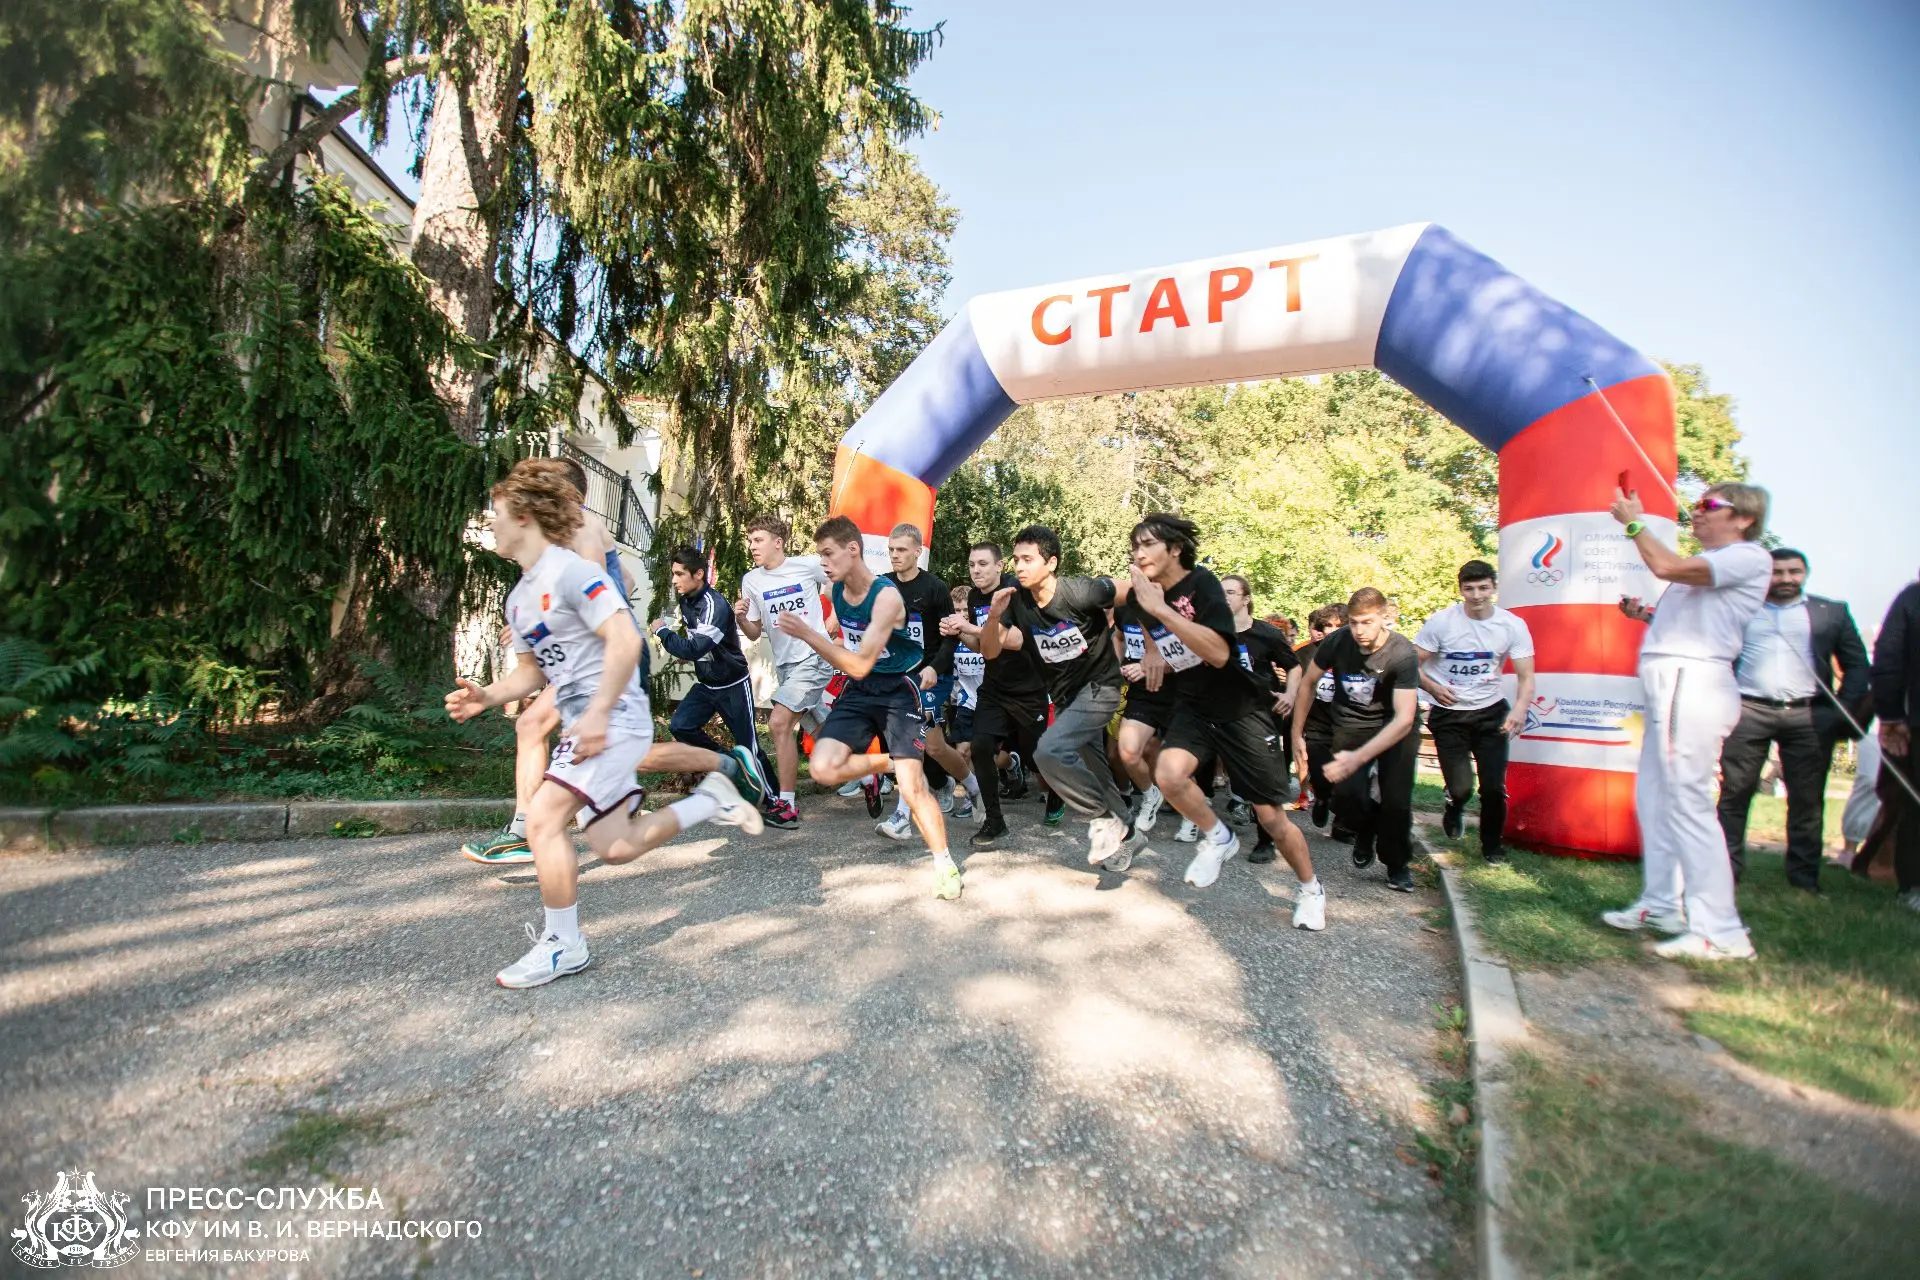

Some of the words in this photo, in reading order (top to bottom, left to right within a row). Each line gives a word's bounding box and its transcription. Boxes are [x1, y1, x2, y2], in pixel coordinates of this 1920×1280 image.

[1031, 253, 1320, 345] СТАРТ
[1584, 561, 1647, 572] РЕСПУБЛИК
[769, 597, 805, 615] 4428
[1040, 633, 1081, 651] 4495
[1162, 641, 1185, 659] 449
[1449, 663, 1491, 676] 4482
